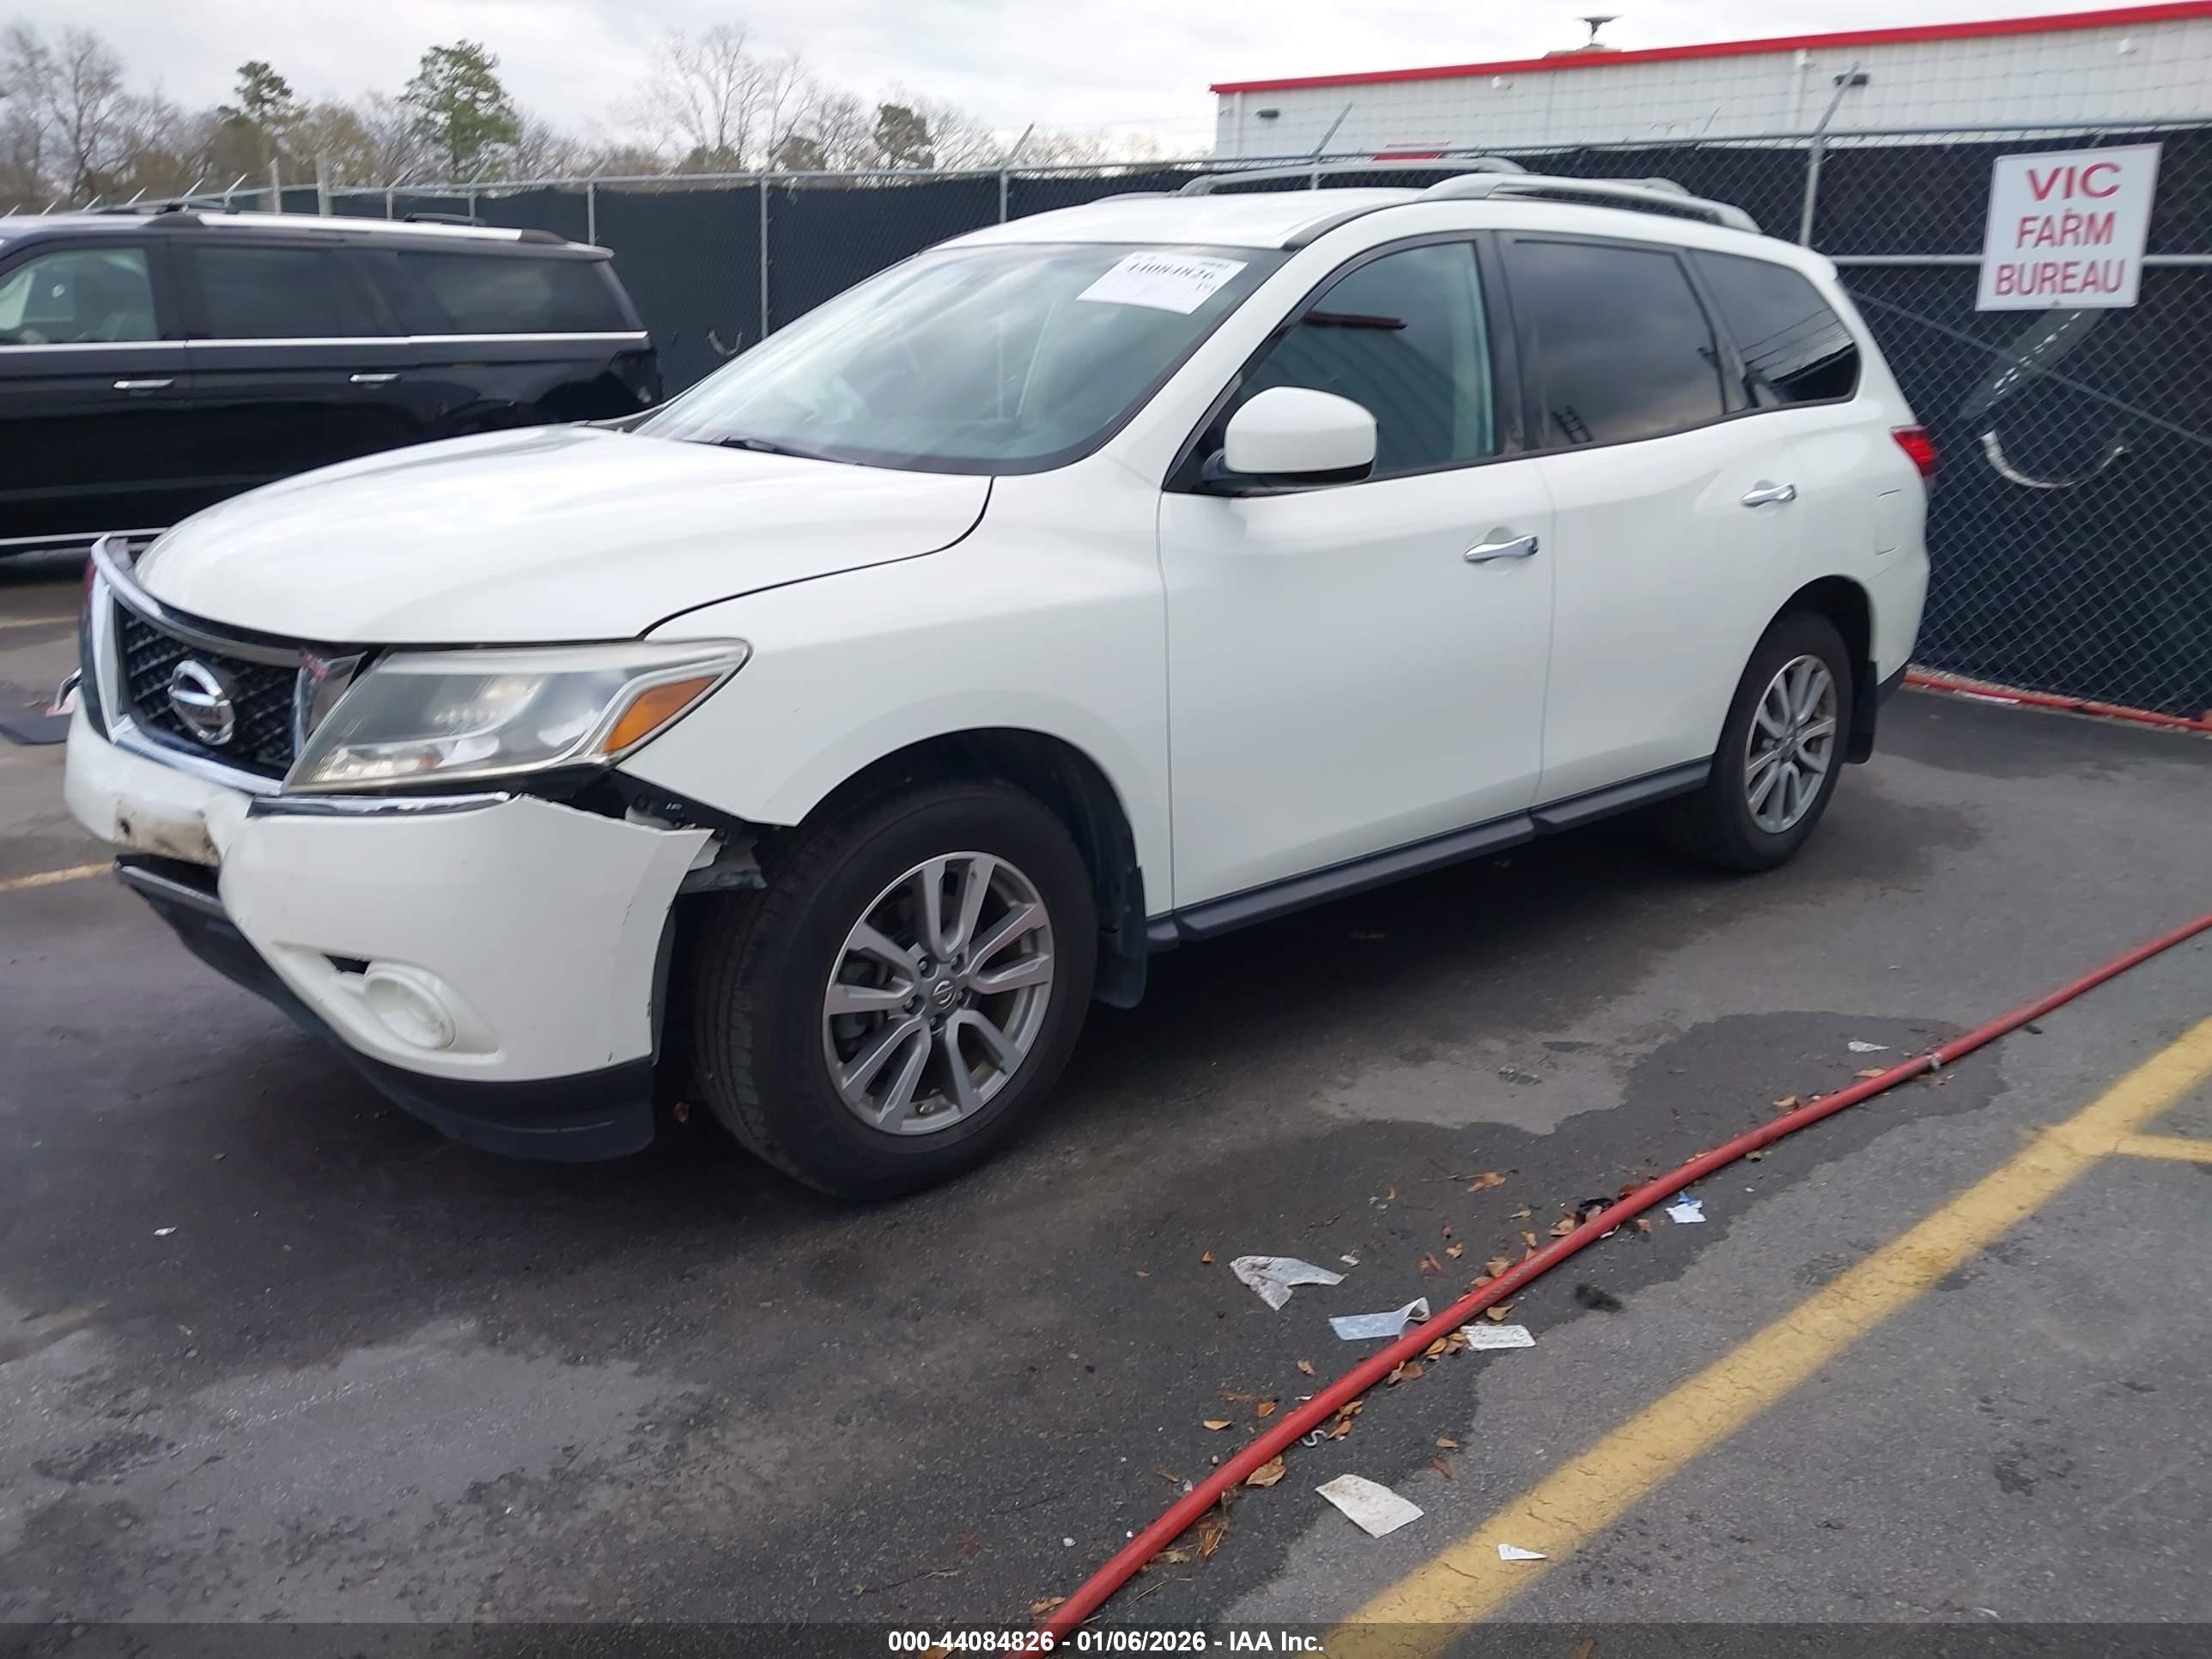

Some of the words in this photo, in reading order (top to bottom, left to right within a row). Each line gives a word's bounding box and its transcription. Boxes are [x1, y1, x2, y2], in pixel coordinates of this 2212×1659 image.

[2027, 161, 2122, 201] VIC
[2015, 211, 2117, 249] FARM
[1994, 258, 2126, 296] BUREAU
